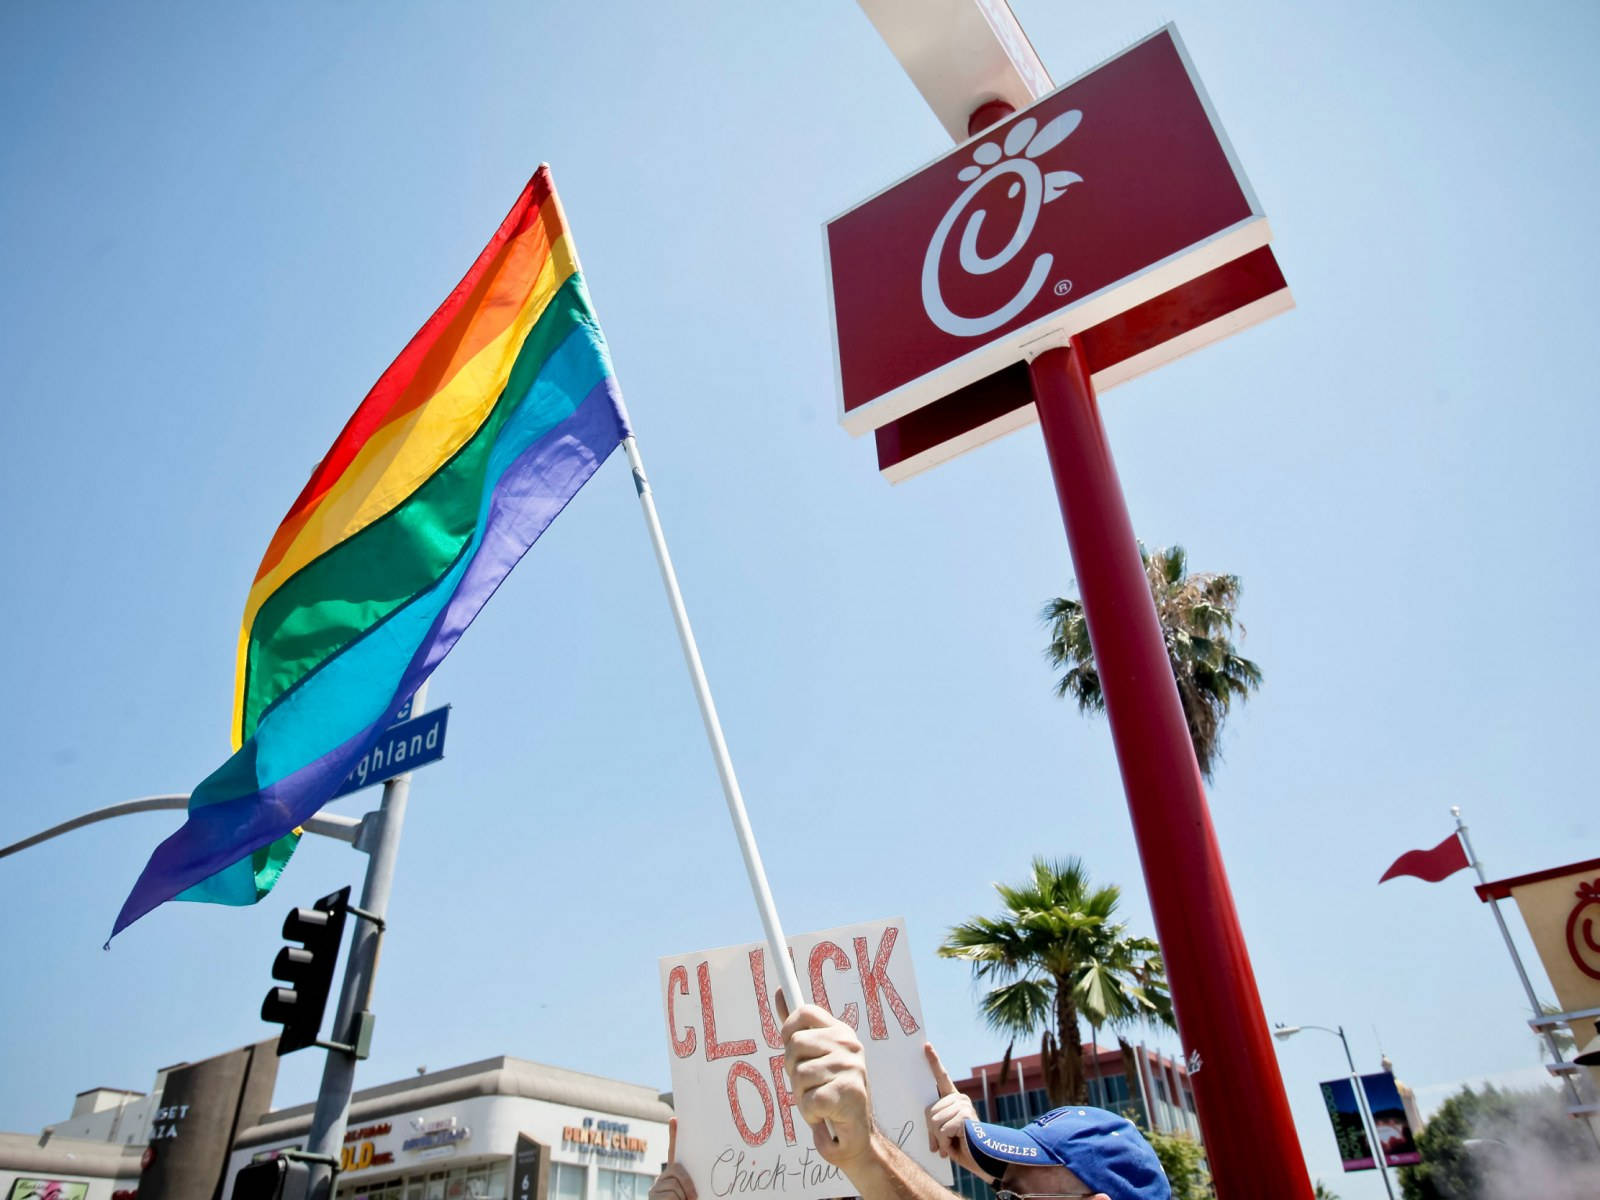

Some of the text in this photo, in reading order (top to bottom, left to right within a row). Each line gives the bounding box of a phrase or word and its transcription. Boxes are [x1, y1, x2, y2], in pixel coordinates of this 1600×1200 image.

[562, 1126, 609, 1148] DENTAL
[971, 1122, 1038, 1157] LOS ANGELES
